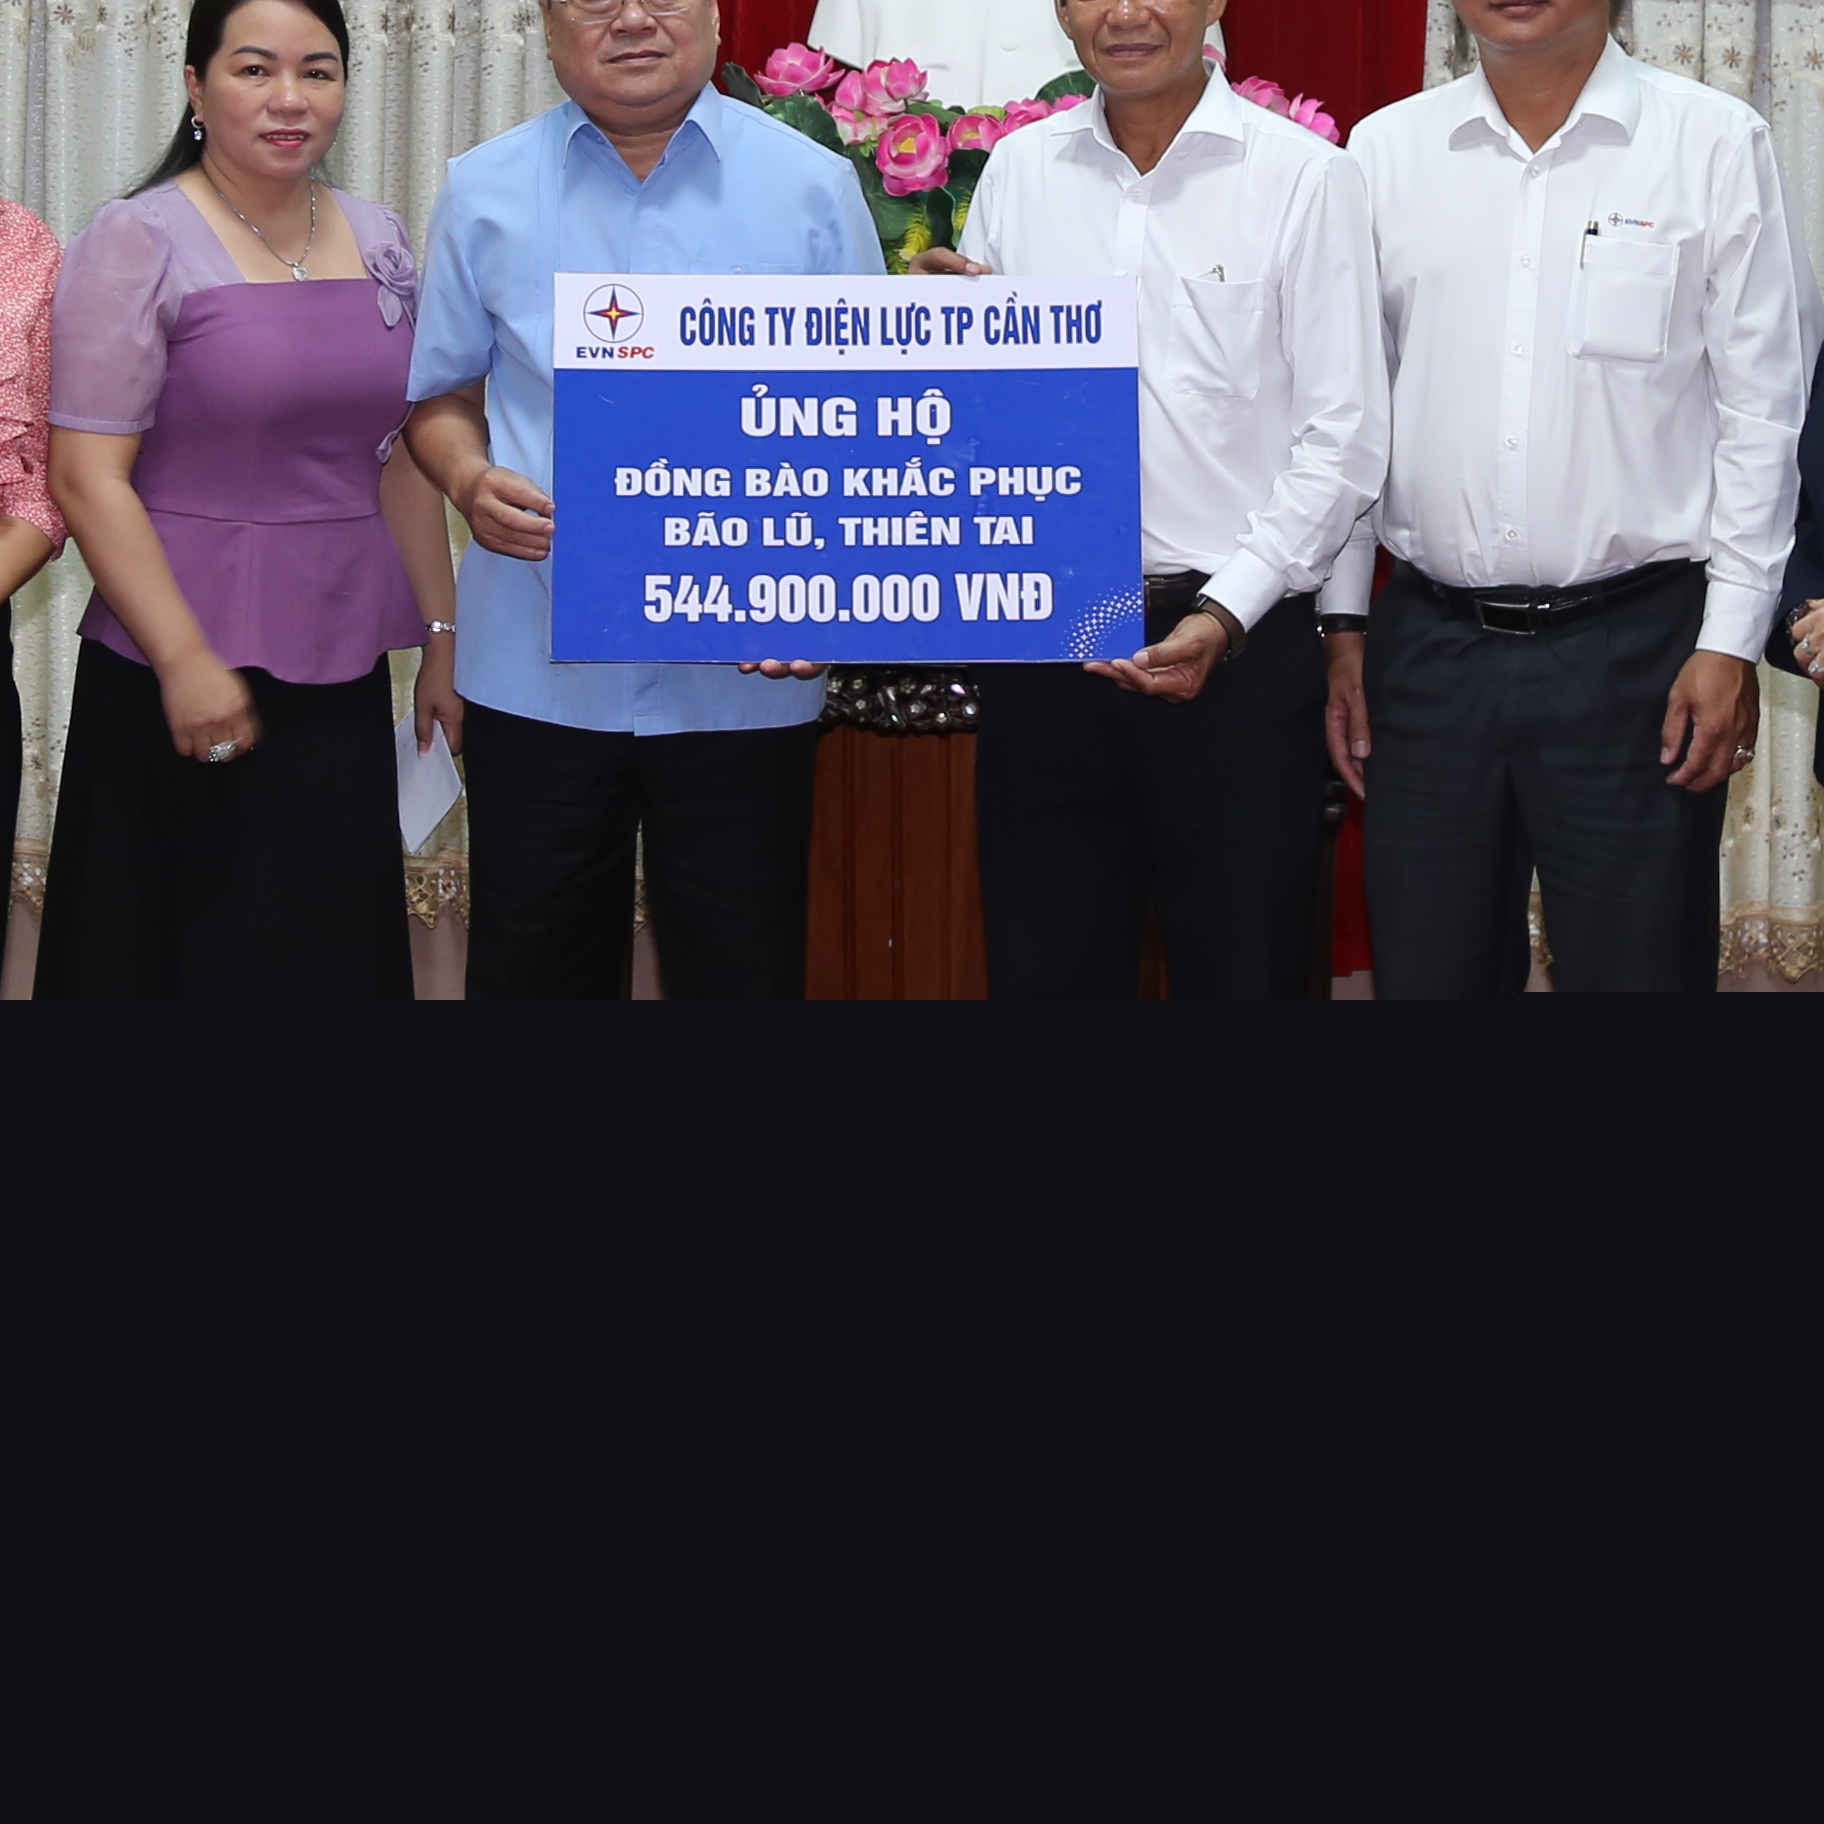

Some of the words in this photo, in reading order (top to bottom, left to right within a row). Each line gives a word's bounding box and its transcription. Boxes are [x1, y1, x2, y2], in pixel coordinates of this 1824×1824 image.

[679, 298, 756, 347] CÔNG
[765, 307, 797, 346] TY
[805, 298, 871, 356] ĐIỆN
[880, 302, 933, 356] LỰC
[942, 306, 975, 346] TP
[984, 291, 1042, 346] CẦN
[1050, 300, 1103, 345] THƠ
[740, 383, 859, 438] ỦNG
[876, 387, 953, 446] HỘ
[614, 458, 732, 498] ĐỒNG
[745, 462, 830, 498] BÀO
[843, 457, 956, 498] KHẮC
[969, 465, 1083, 503] PHỤC
[664, 511, 749, 548] BÃO
[762, 512, 826, 551] LŨ,
[838, 511, 961, 547] THIÊN
[973, 516, 1034, 546] TAI
[644, 574, 942, 624] 544.900.000
[954, 572, 1055, 622] VNĐ
